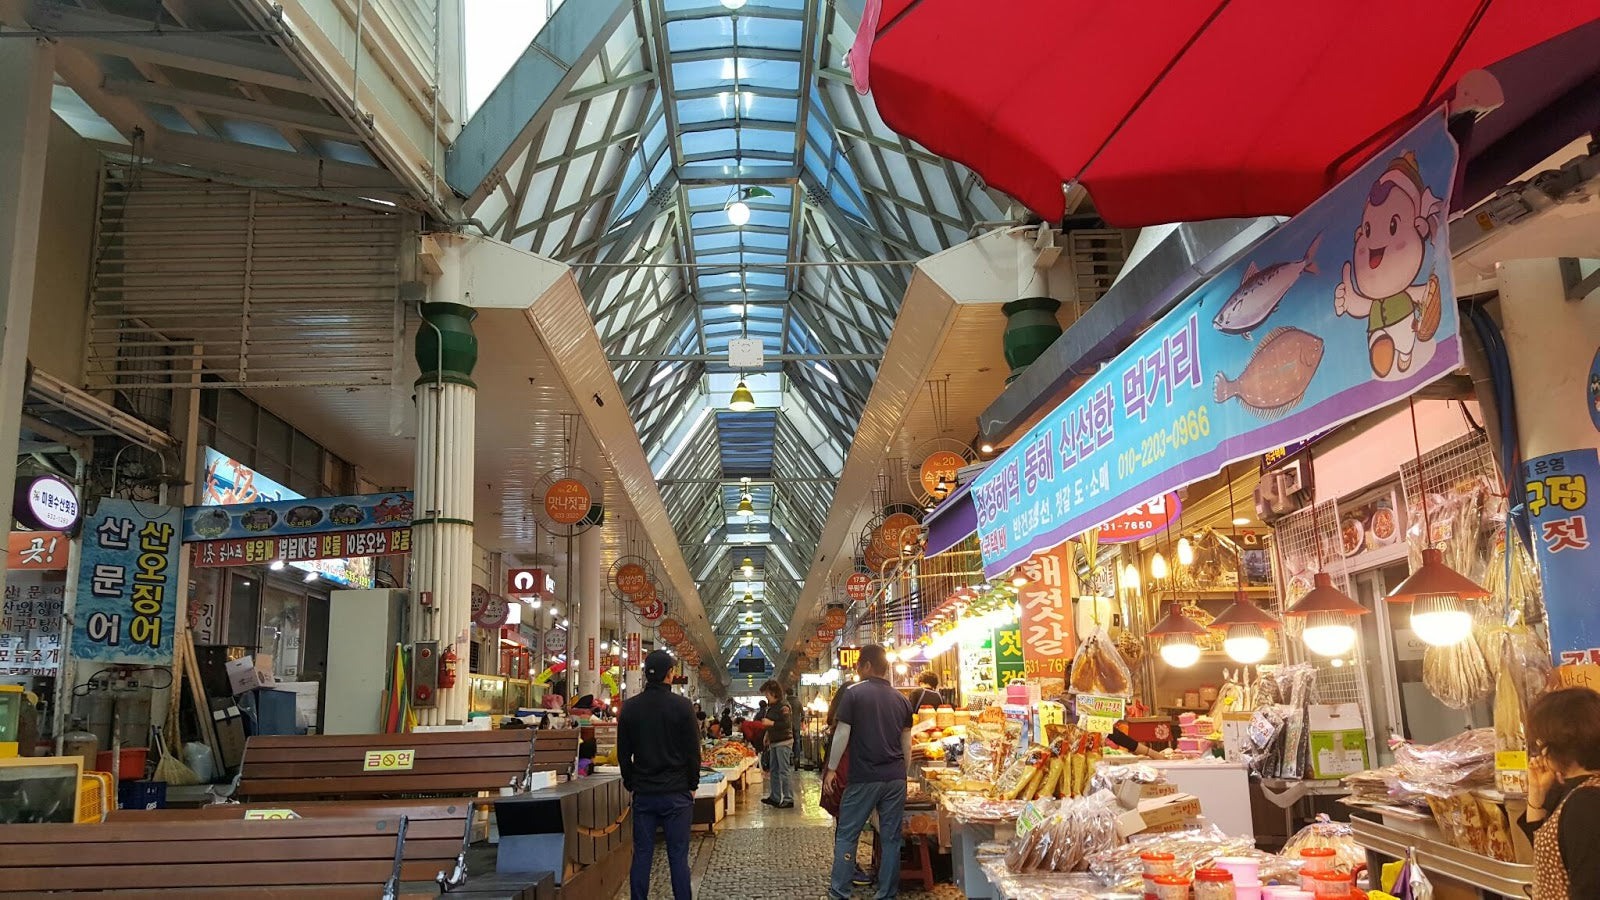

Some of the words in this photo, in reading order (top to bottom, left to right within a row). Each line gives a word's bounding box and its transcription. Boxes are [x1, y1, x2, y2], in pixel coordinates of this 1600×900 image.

[975, 456, 1020, 528] 청정해역
[1024, 428, 1054, 496] 동해
[1059, 381, 1115, 472] 신선한
[1123, 312, 1203, 423] 먹거리
[1118, 405, 1210, 479] 010-2203-0966
[548, 496, 588, 510] 맛나젓갈
[130, 520, 175, 647] 산오징어
